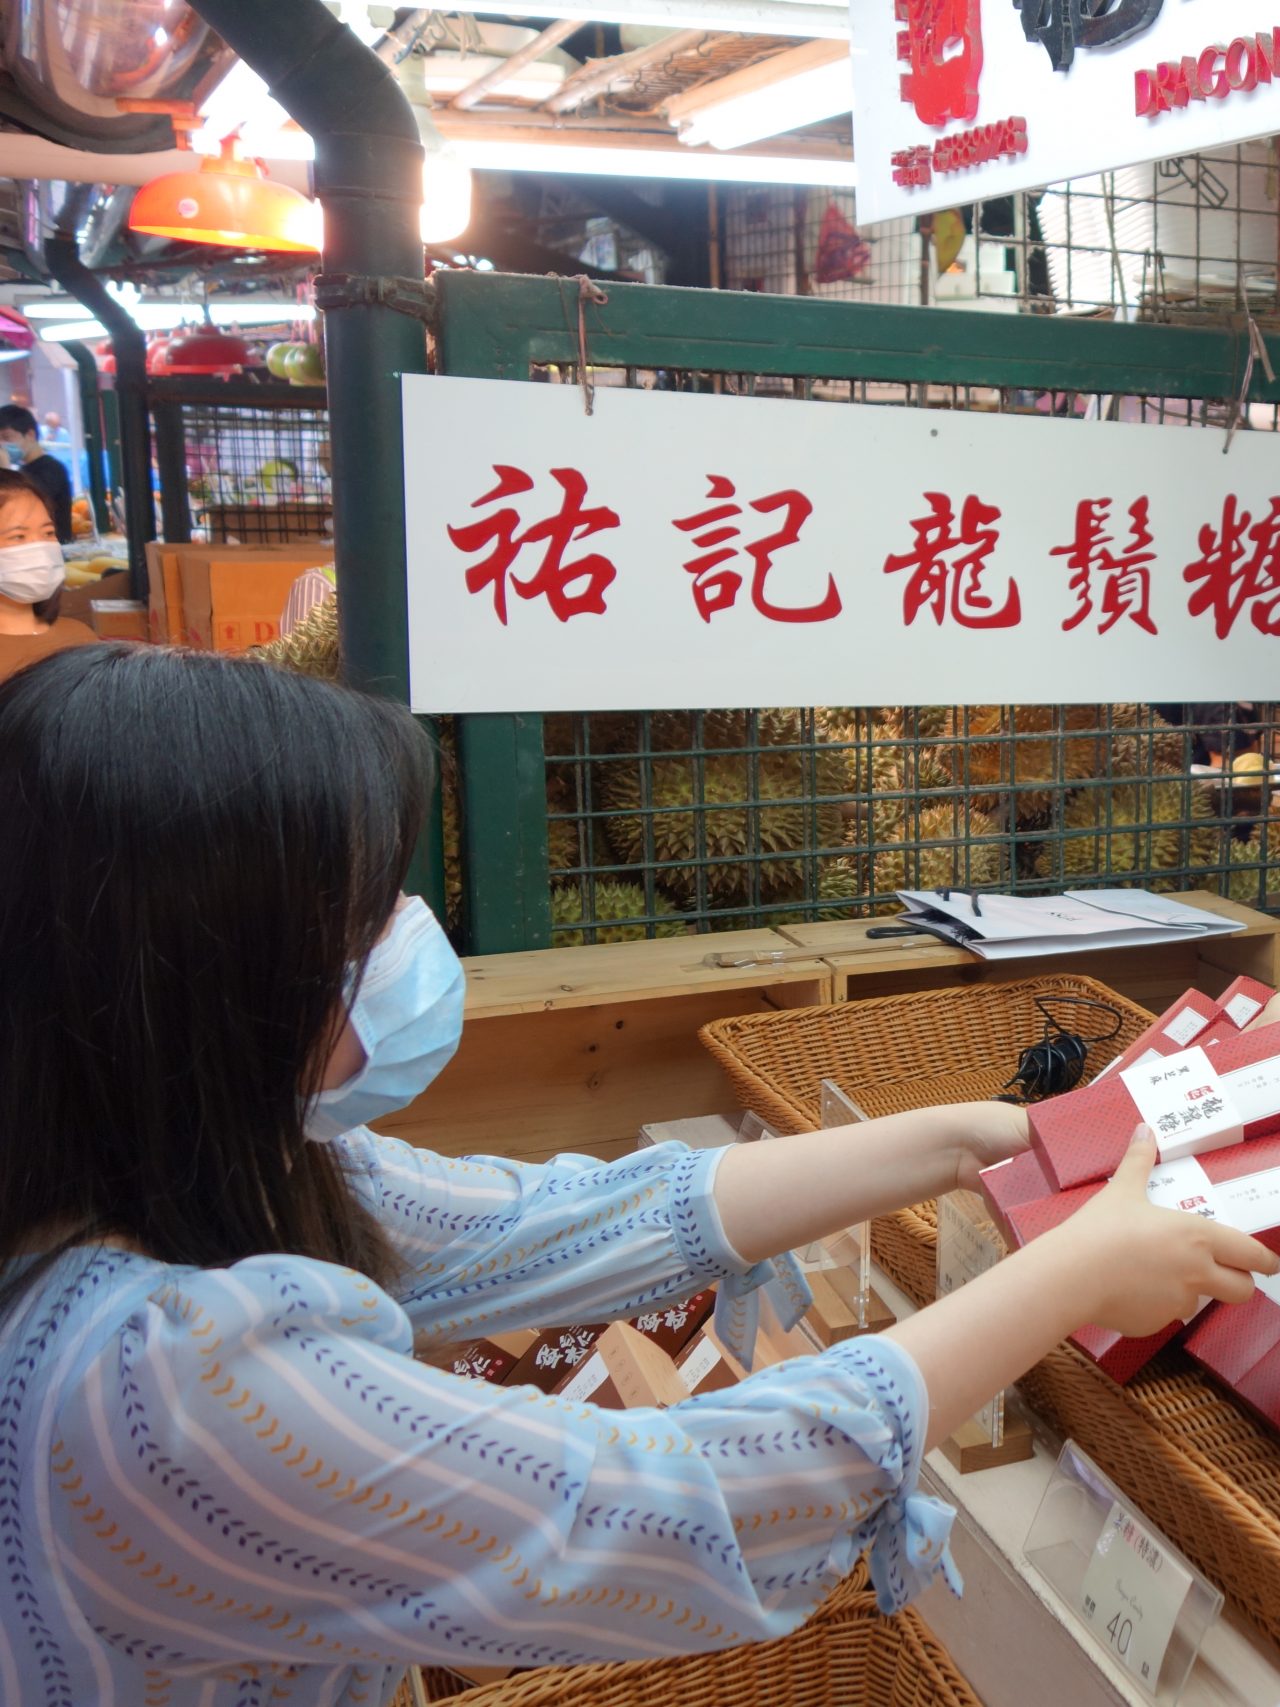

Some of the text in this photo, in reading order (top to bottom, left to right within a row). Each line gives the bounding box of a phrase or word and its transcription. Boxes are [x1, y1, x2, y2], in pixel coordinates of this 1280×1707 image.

[1157, 1097, 1224, 1132] 龍鬚糖
[1106, 1611, 1133, 1656] 40
